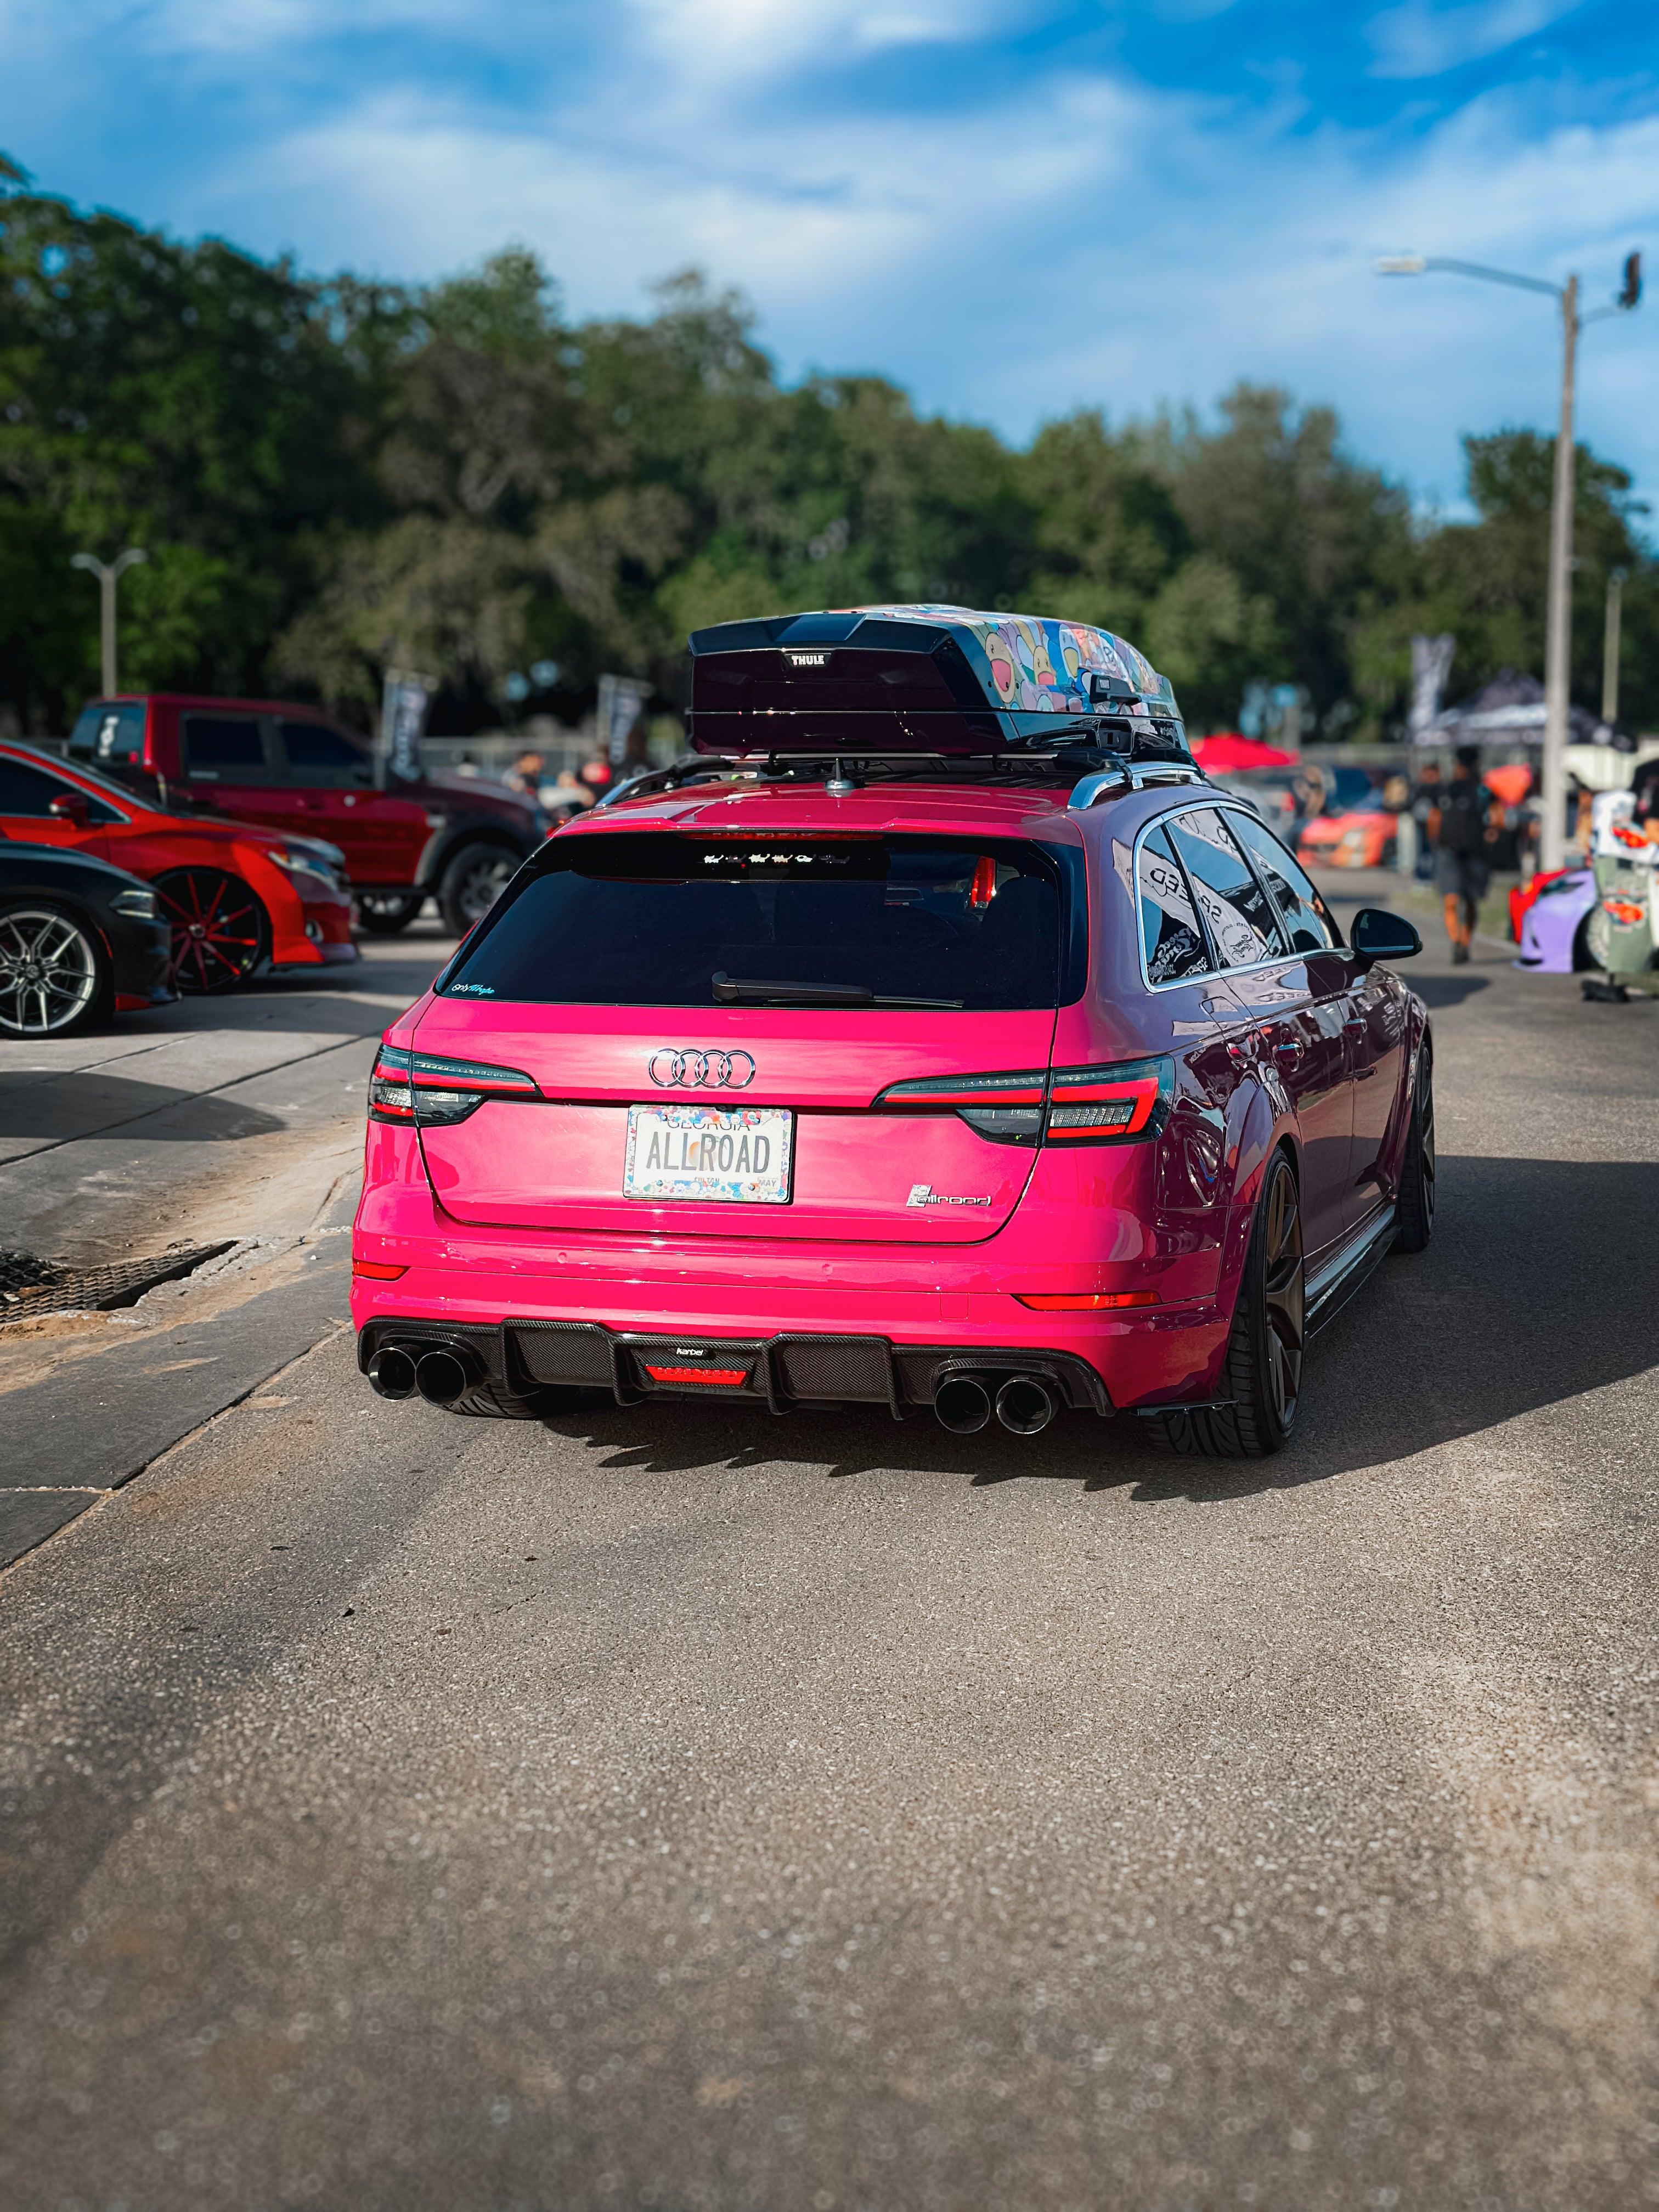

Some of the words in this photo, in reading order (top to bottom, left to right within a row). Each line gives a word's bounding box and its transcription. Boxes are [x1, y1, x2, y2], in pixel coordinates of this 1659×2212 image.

[792, 655, 824, 665] THULE
[646, 1131, 770, 1173] ALLROAD
[758, 1179, 776, 1187] MAY
[917, 1194, 991, 1206] allroad
